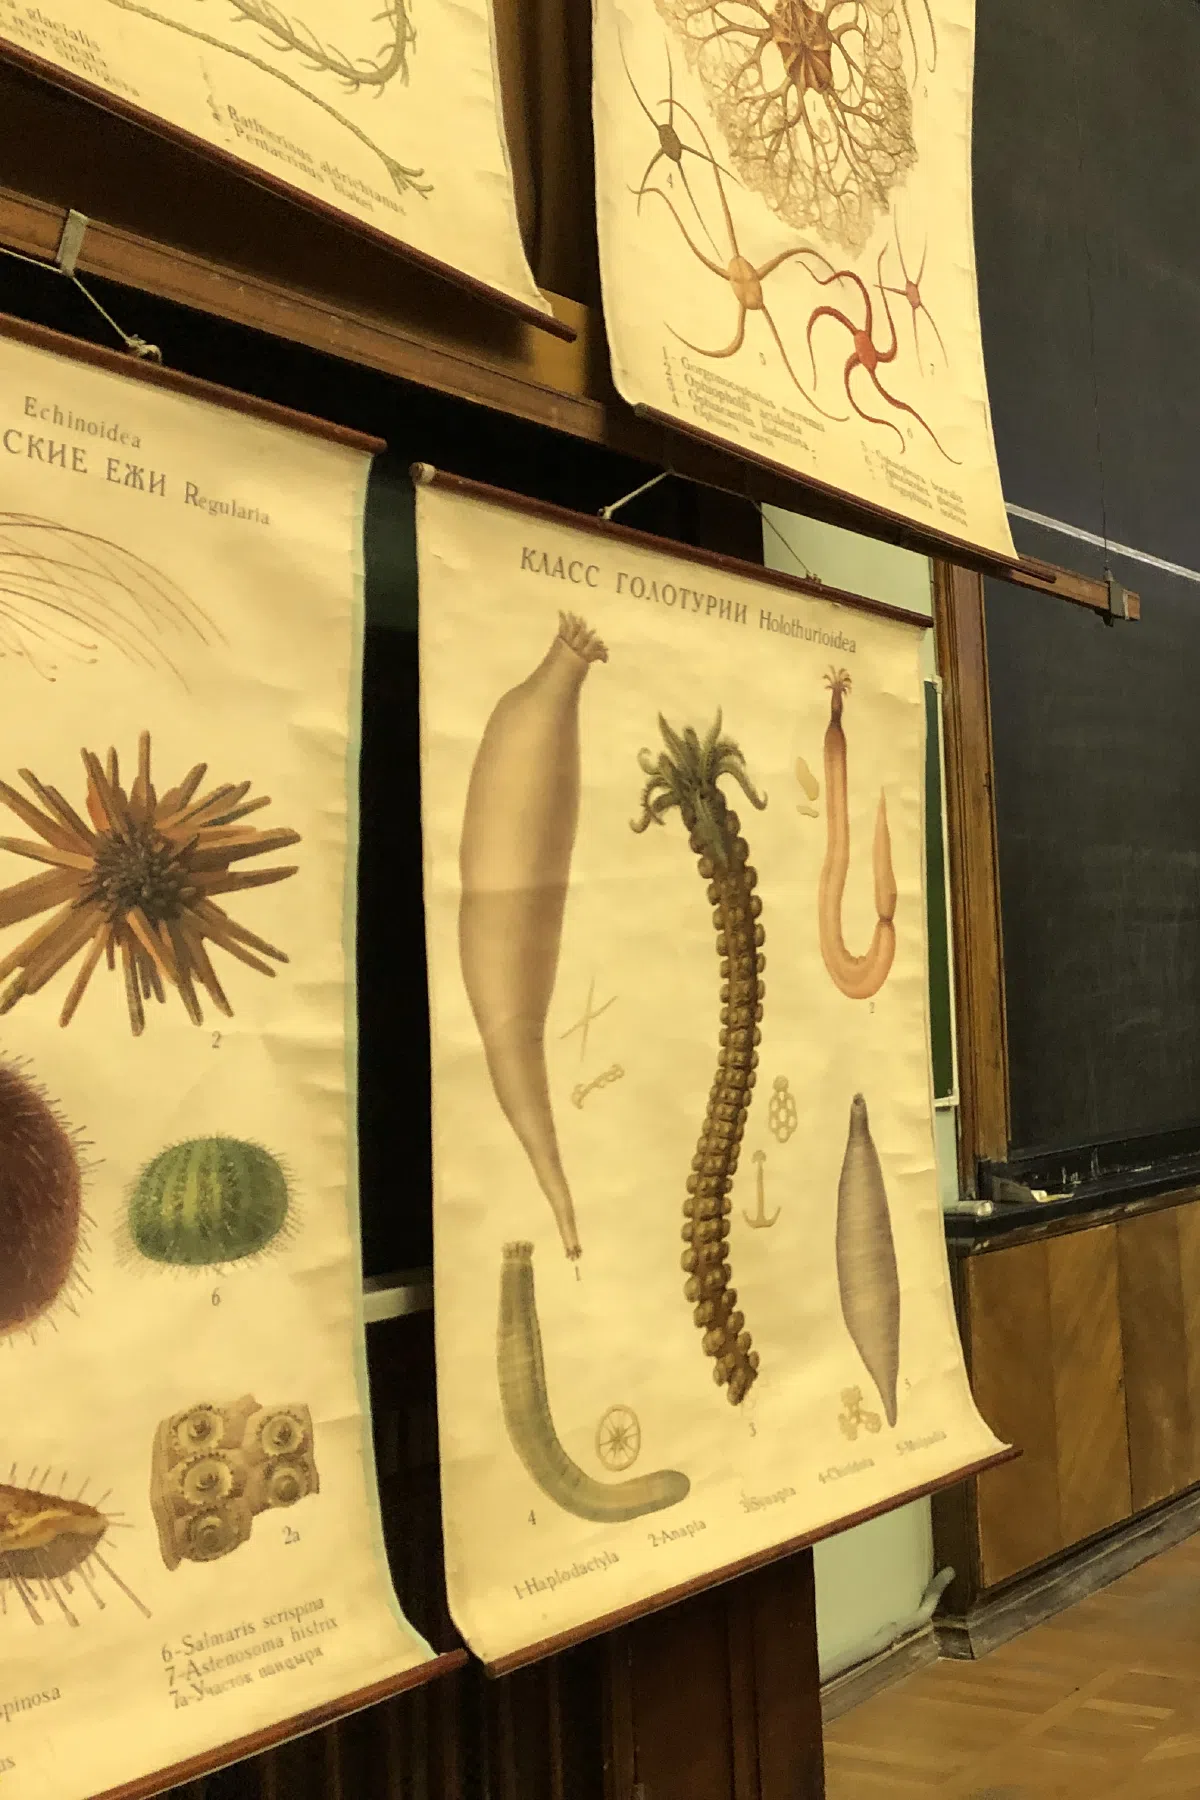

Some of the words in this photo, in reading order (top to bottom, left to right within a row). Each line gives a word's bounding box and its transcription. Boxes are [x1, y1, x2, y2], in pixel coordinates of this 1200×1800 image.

[24, 395, 142, 449] Echinoidea
[106, 456, 167, 497] ЕЖИ
[184, 480, 271, 525] Regularia
[520, 546, 601, 588] КЛАСС
[616, 571, 749, 625] ГОЛОТУРИИ
[759, 608, 858, 654] Holothurioidea
[211, 1031, 221, 1049] 2
[211, 1286, 221, 1307] 6
[527, 1509, 537, 1526] 4
[0, 1686, 62, 1723] pinosa
